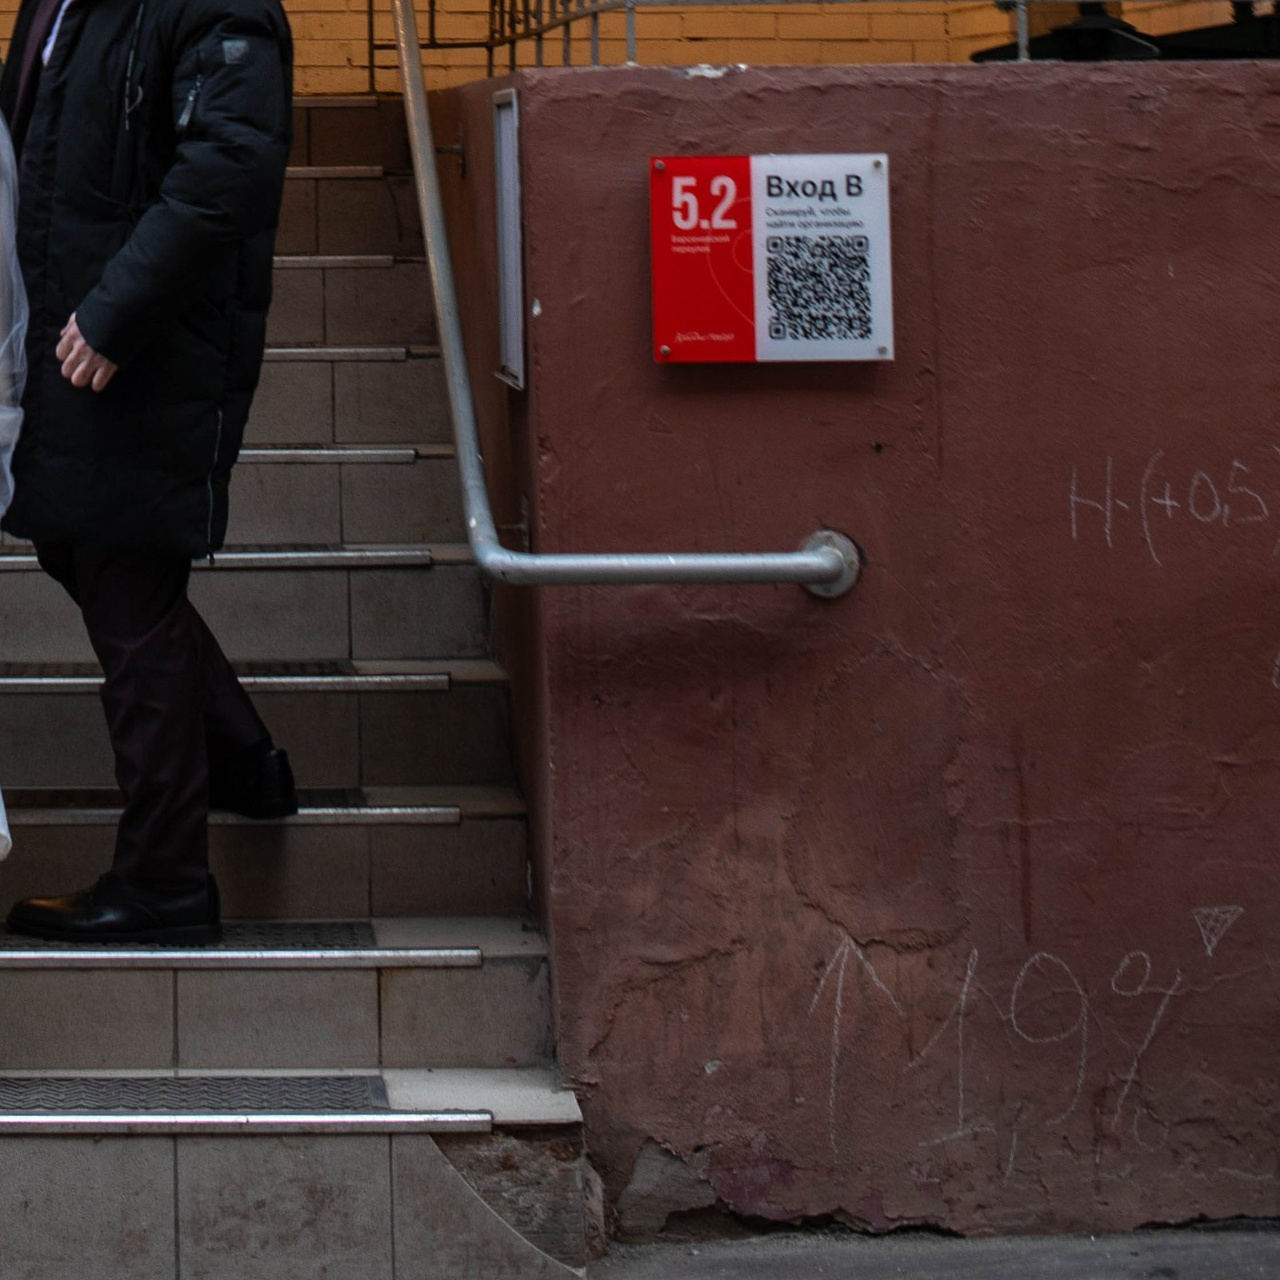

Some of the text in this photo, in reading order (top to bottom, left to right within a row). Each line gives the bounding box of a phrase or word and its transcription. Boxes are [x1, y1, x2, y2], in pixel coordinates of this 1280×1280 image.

[672, 175, 738, 230] 5.2
[766, 173, 864, 202] Вход В
